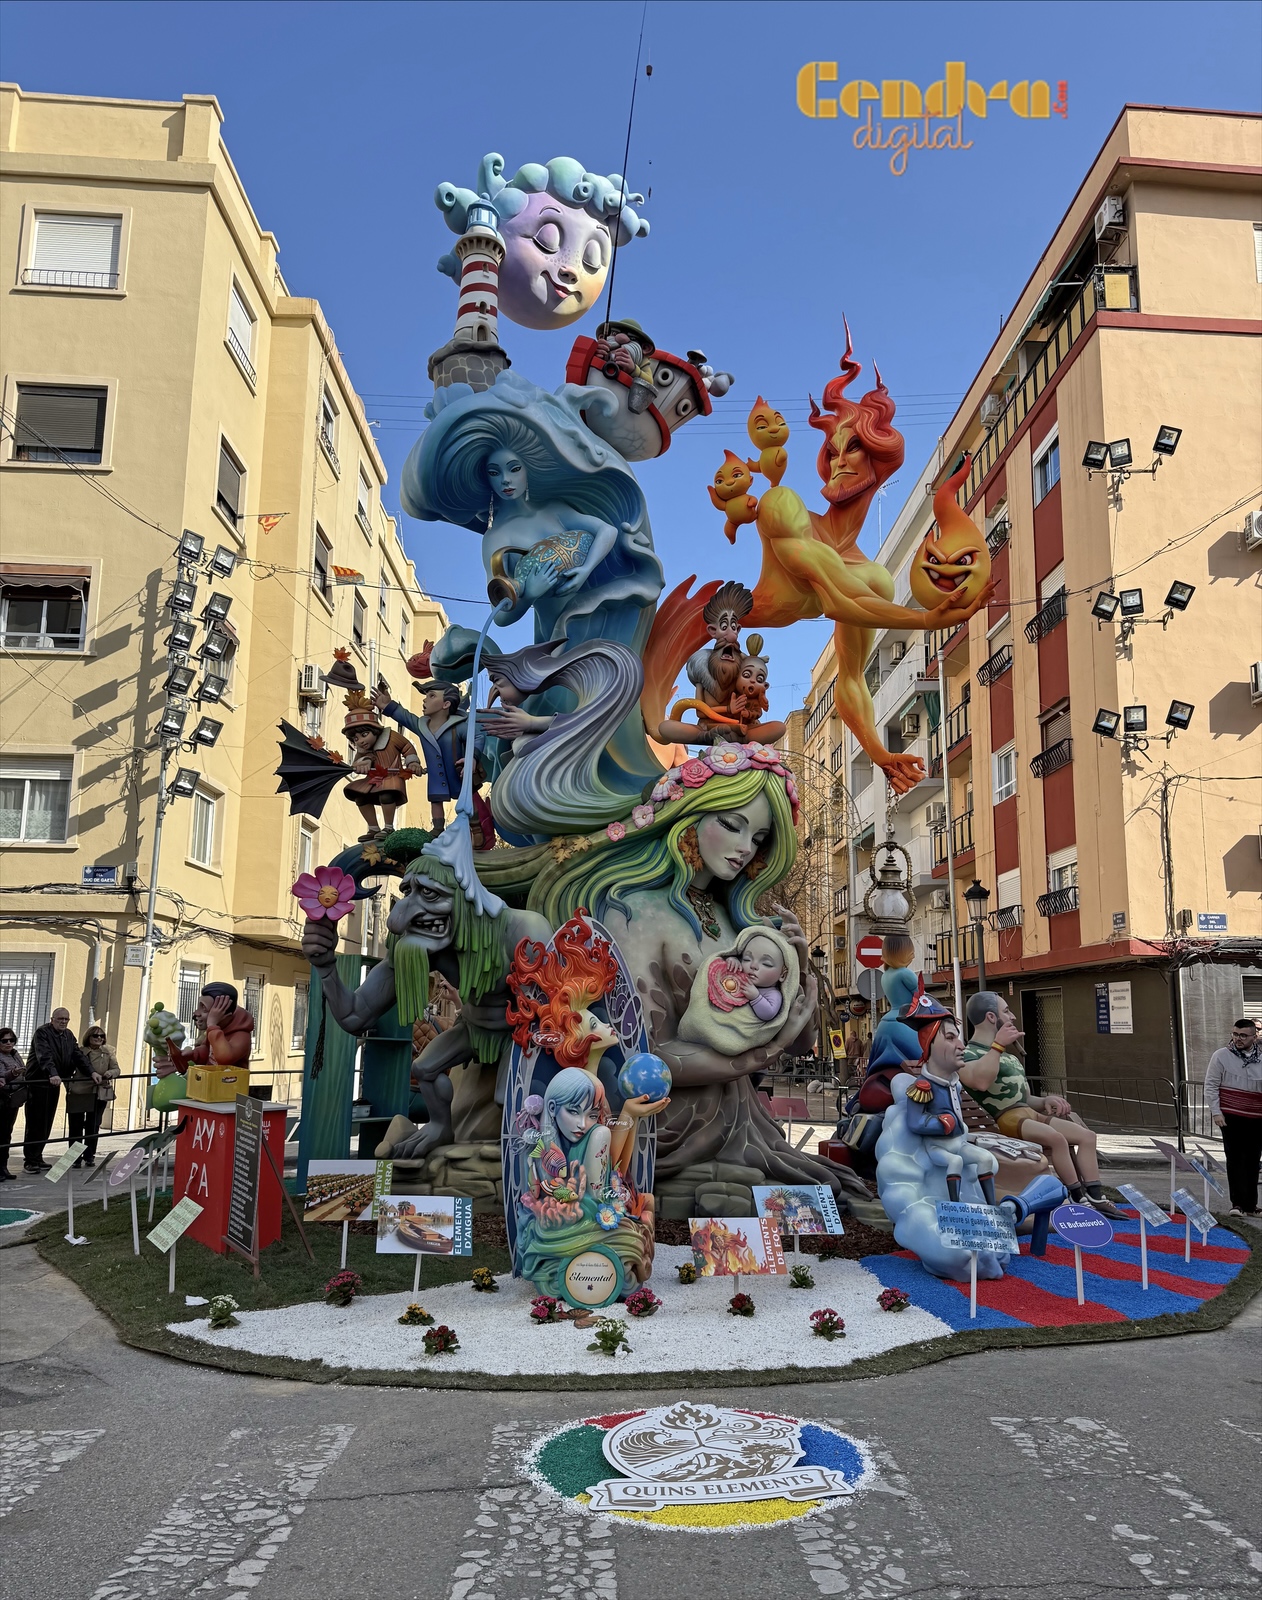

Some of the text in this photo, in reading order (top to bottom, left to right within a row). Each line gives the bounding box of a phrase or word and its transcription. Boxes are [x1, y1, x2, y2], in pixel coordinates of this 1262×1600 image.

[373, 1160, 384, 1219] ELEMENTS
[383, 1162, 393, 1195] ERRA
[454, 1197, 463, 1255] ELEMENTS
[465, 1203, 473, 1249] D'AIGUA
[816, 1186, 835, 1234] ELEMENTS
[826, 1194, 840, 1225] D'AIRE
[760, 1218, 777, 1274] ELEMENTS
[772, 1227, 785, 1265] DE FOC
[569, 1272, 614, 1282] Elemental
[622, 1474, 814, 1498] QUINS ELEMENTS
